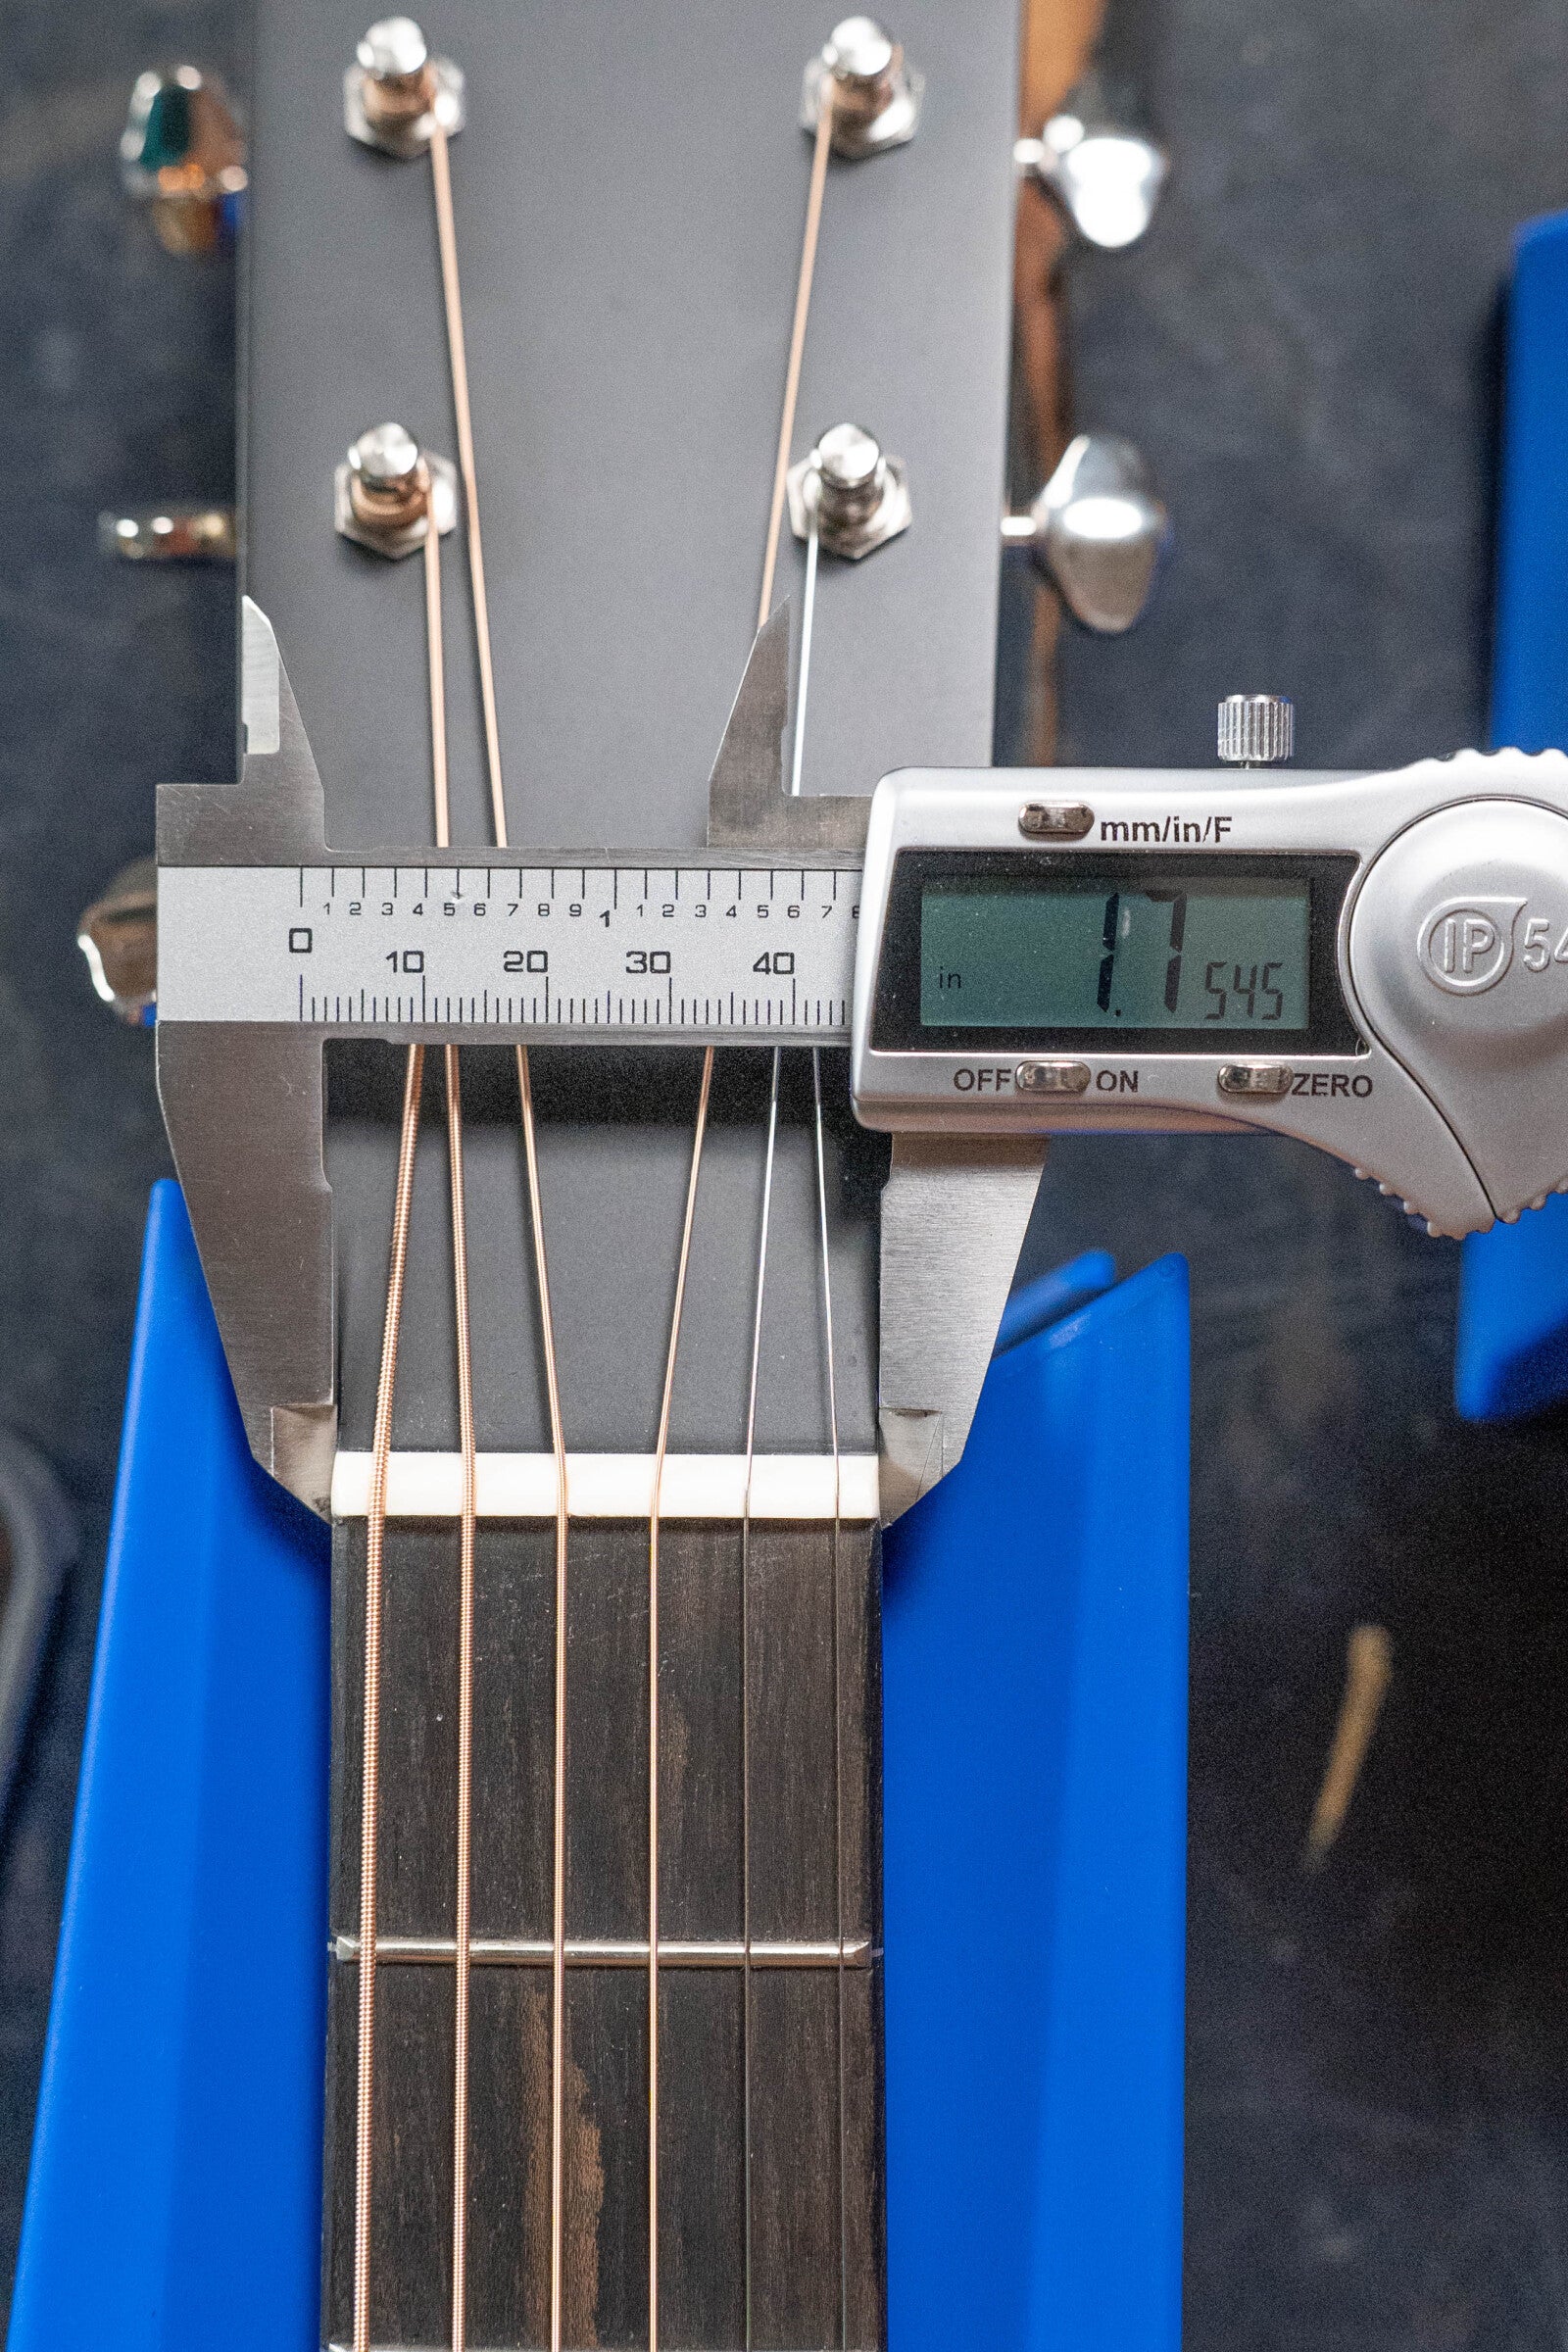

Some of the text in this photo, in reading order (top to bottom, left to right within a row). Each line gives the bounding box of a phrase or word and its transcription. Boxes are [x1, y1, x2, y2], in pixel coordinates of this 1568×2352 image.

[1100, 815, 1233, 844] mm/in/F
[323, 903, 331, 915] 1
[349, 902, 362, 916] 2
[381, 902, 394, 916] 3
[412, 903, 424, 916] 4
[443, 902, 456, 916] 5
[473, 903, 486, 917] 6
[507, 903, 519, 917] 7
[537, 903, 551, 917] 8
[568, 903, 582, 917] 9
[599, 909, 611, 928] 1
[636, 904, 644, 917] 1
[662, 904, 675, 918] 2
[695, 904, 708, 918] 3
[725, 905, 737, 918] 4
[757, 905, 769, 919] 5
[787, 905, 801, 919] 6
[821, 906, 833, 918] 7
[288, 927, 314, 954] 0
[1444, 917, 1495, 974] IP
[385, 950, 795, 975] 10 20 30 40
[938, 965, 963, 990] in
[952, 1067, 1374, 1099] OFF ON ZERO
